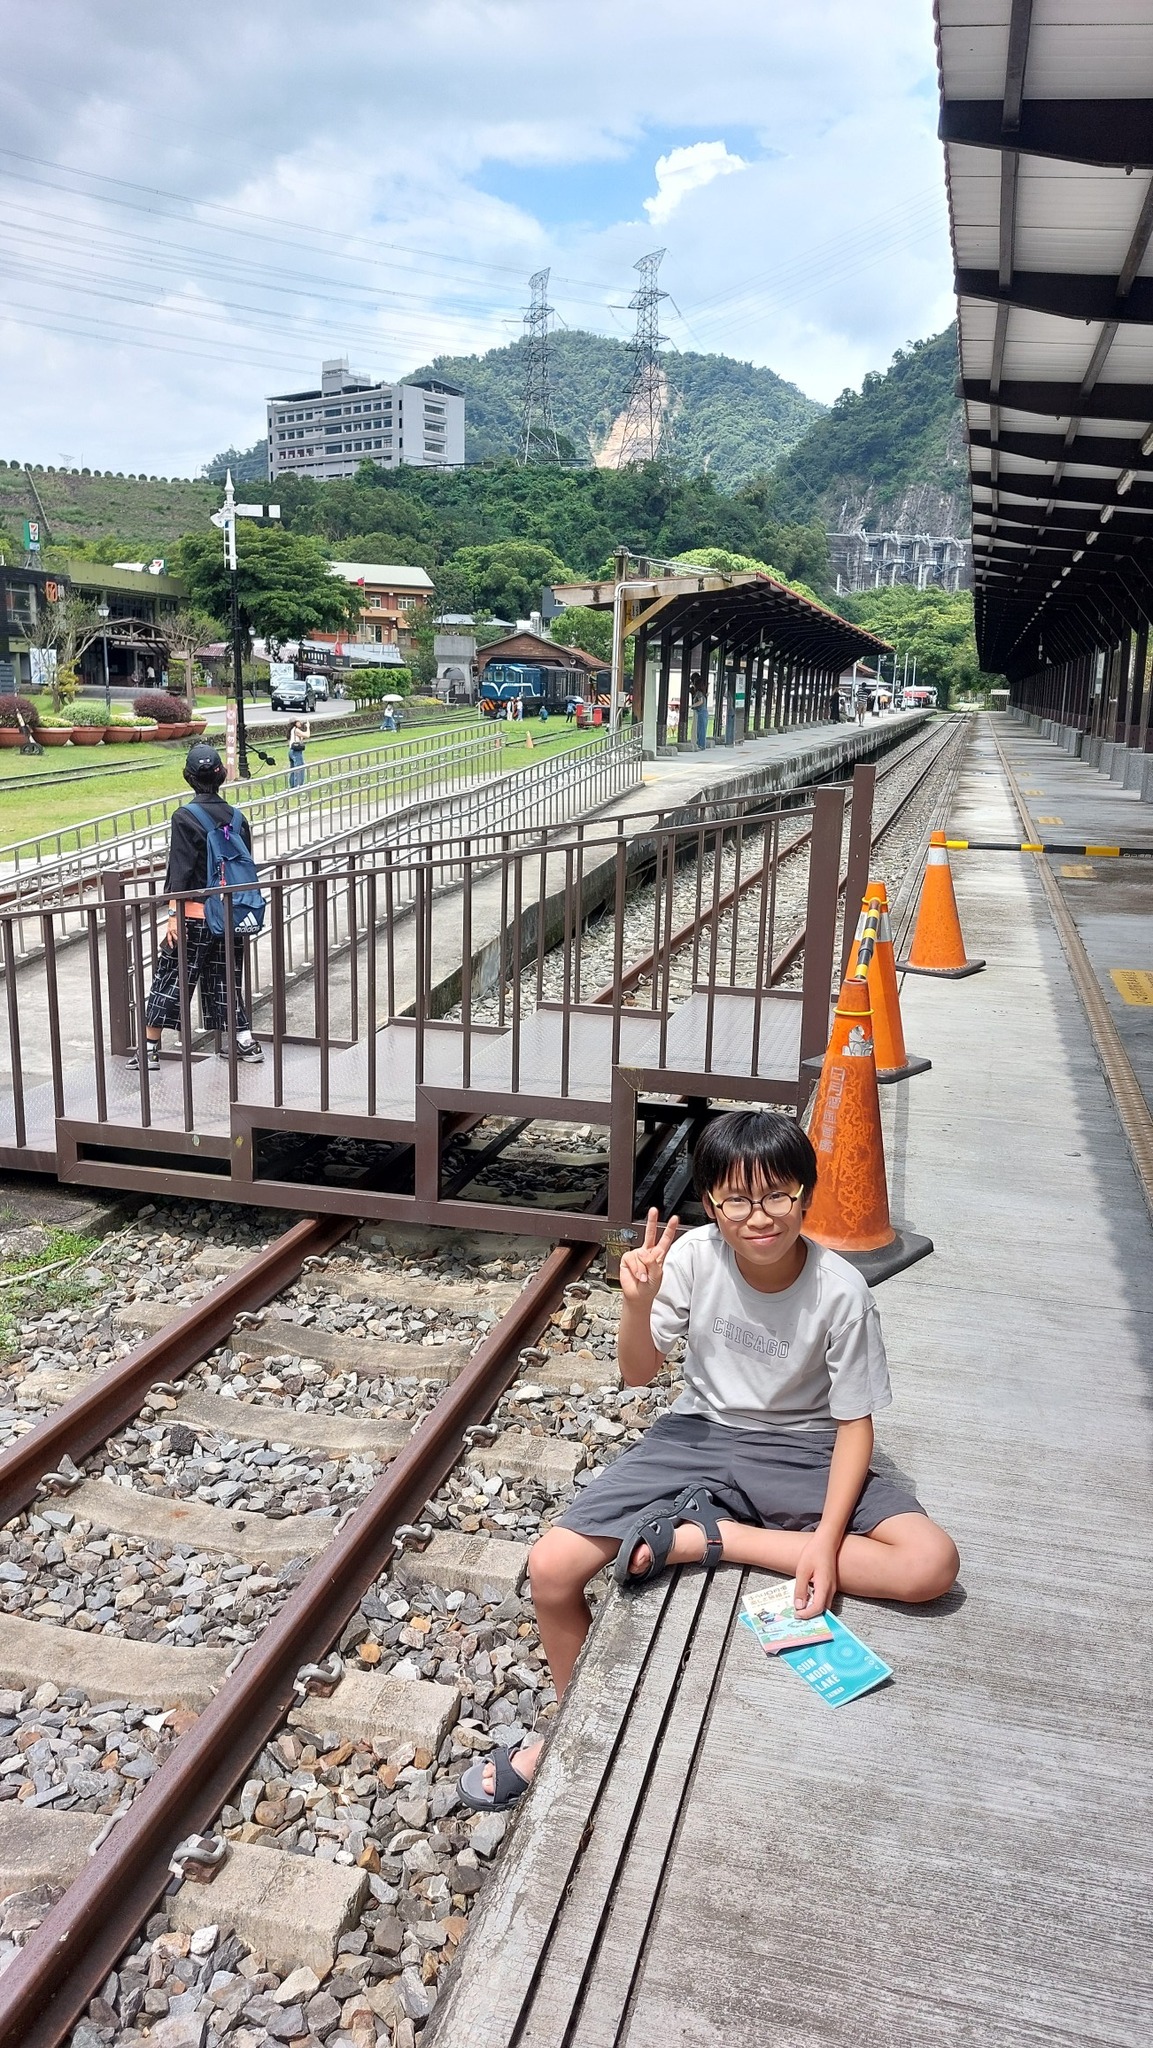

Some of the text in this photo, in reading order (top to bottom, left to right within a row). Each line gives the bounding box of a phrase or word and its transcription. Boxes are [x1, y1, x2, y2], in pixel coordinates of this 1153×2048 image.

[712, 1316, 790, 1359] CHICAGO
[797, 1657, 817, 1674] SUN
[805, 1662, 834, 1683] MOON
[815, 1673, 841, 1691] LAKE
